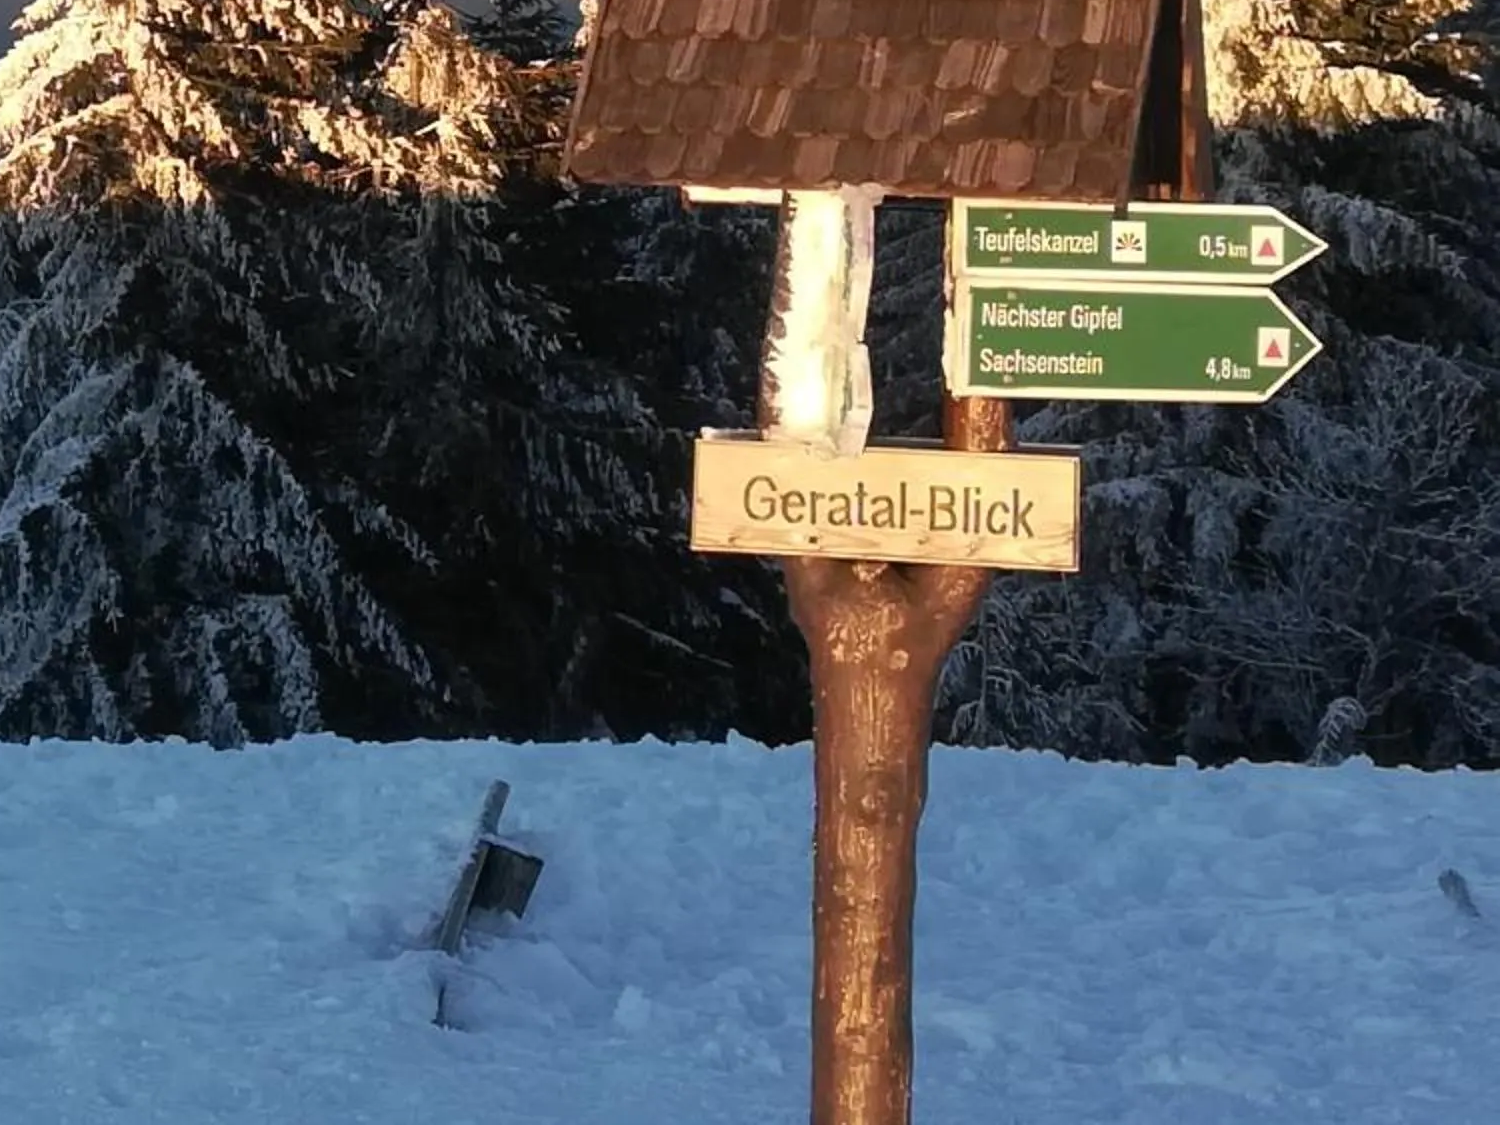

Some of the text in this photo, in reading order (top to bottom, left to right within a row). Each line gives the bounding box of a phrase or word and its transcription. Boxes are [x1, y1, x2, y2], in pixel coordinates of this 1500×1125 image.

[975, 226, 1248, 258] Teufelskanzel 0,5 km
[981, 303, 1123, 333] Nächster Gipfel
[979, 349, 1251, 383] Sachsenstein 4,8 km
[743, 475, 1035, 539] Geratal-Blick
